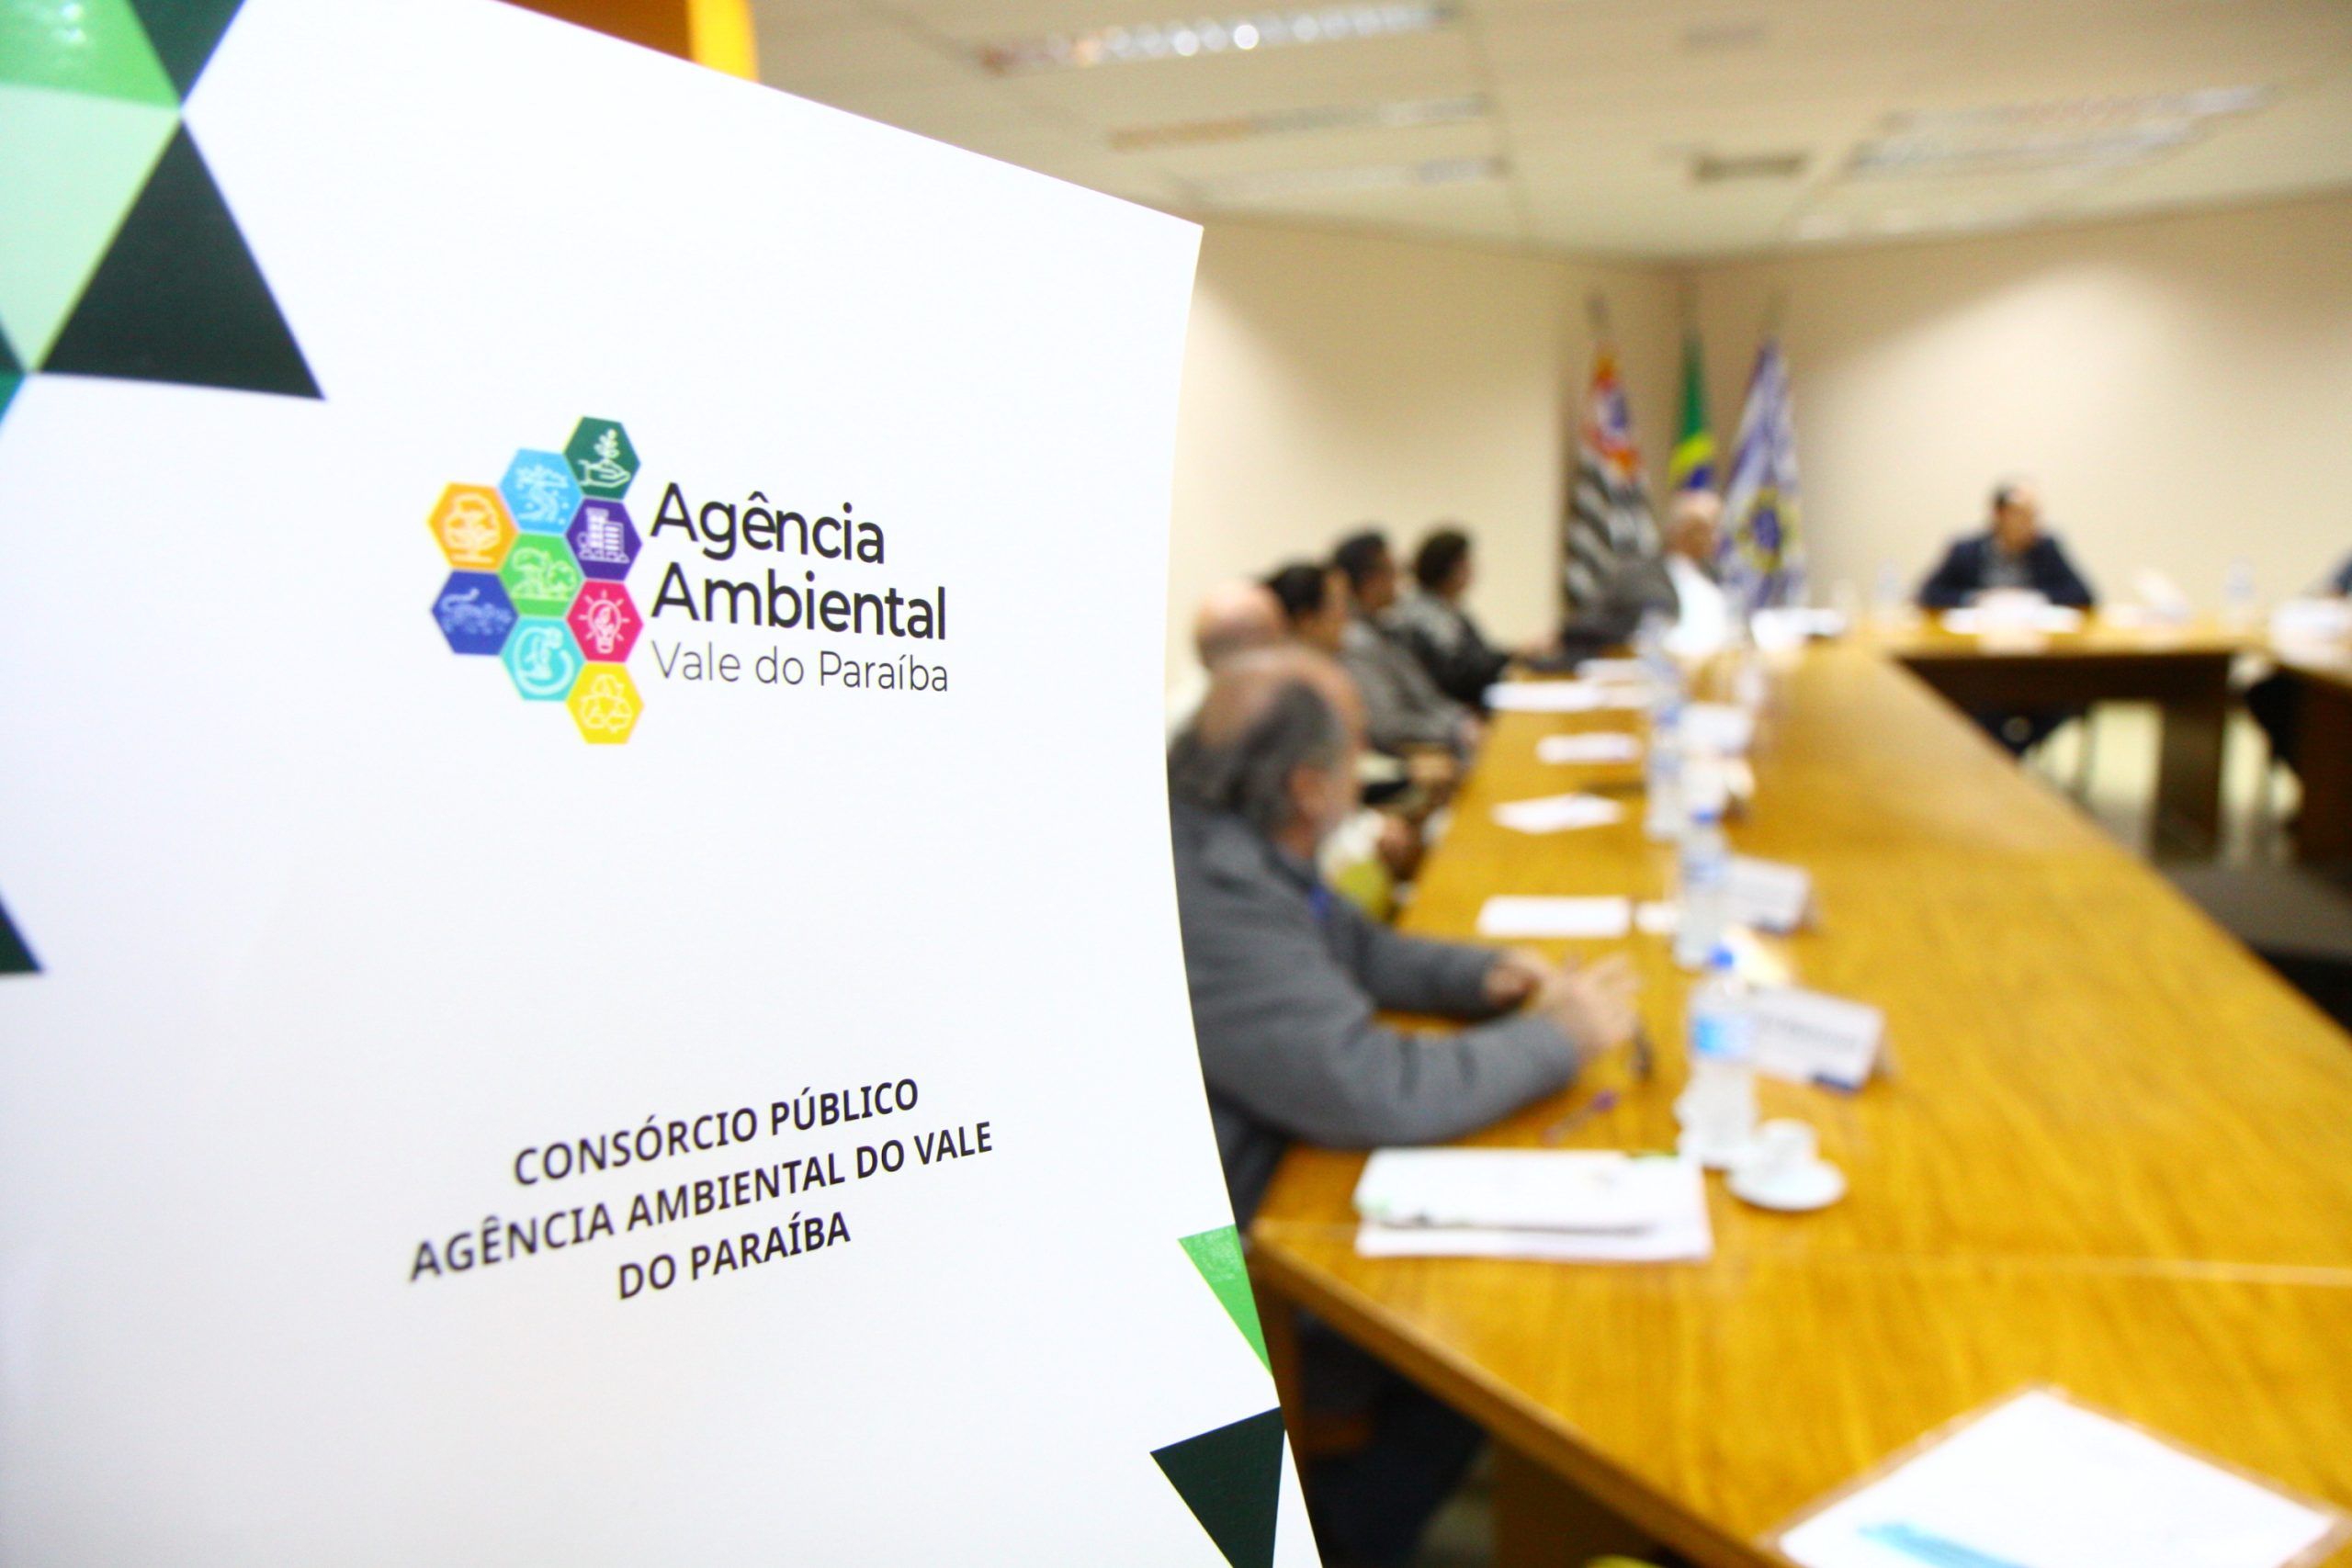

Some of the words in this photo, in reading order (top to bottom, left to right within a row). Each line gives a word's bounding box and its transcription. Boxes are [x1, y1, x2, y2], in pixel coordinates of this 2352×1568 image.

[650, 481, 885, 565] Agência
[650, 561, 946, 640] Ambiental
[651, 640, 741, 682] Vale
[755, 645, 805, 685] do
[820, 649, 948, 693] Paraíba
[514, 1107, 758, 1187] CONSÓRCIO
[771, 1077, 919, 1136] PÚBLICO
[409, 1201, 616, 1282] AGÊNCIA
[626, 1152, 846, 1233] AMBIENTAL
[855, 1139, 905, 1179] DO
[913, 1121, 993, 1166] VALE
[618, 1253, 677, 1301] DO
[690, 1211, 852, 1281] PARAÍBA
